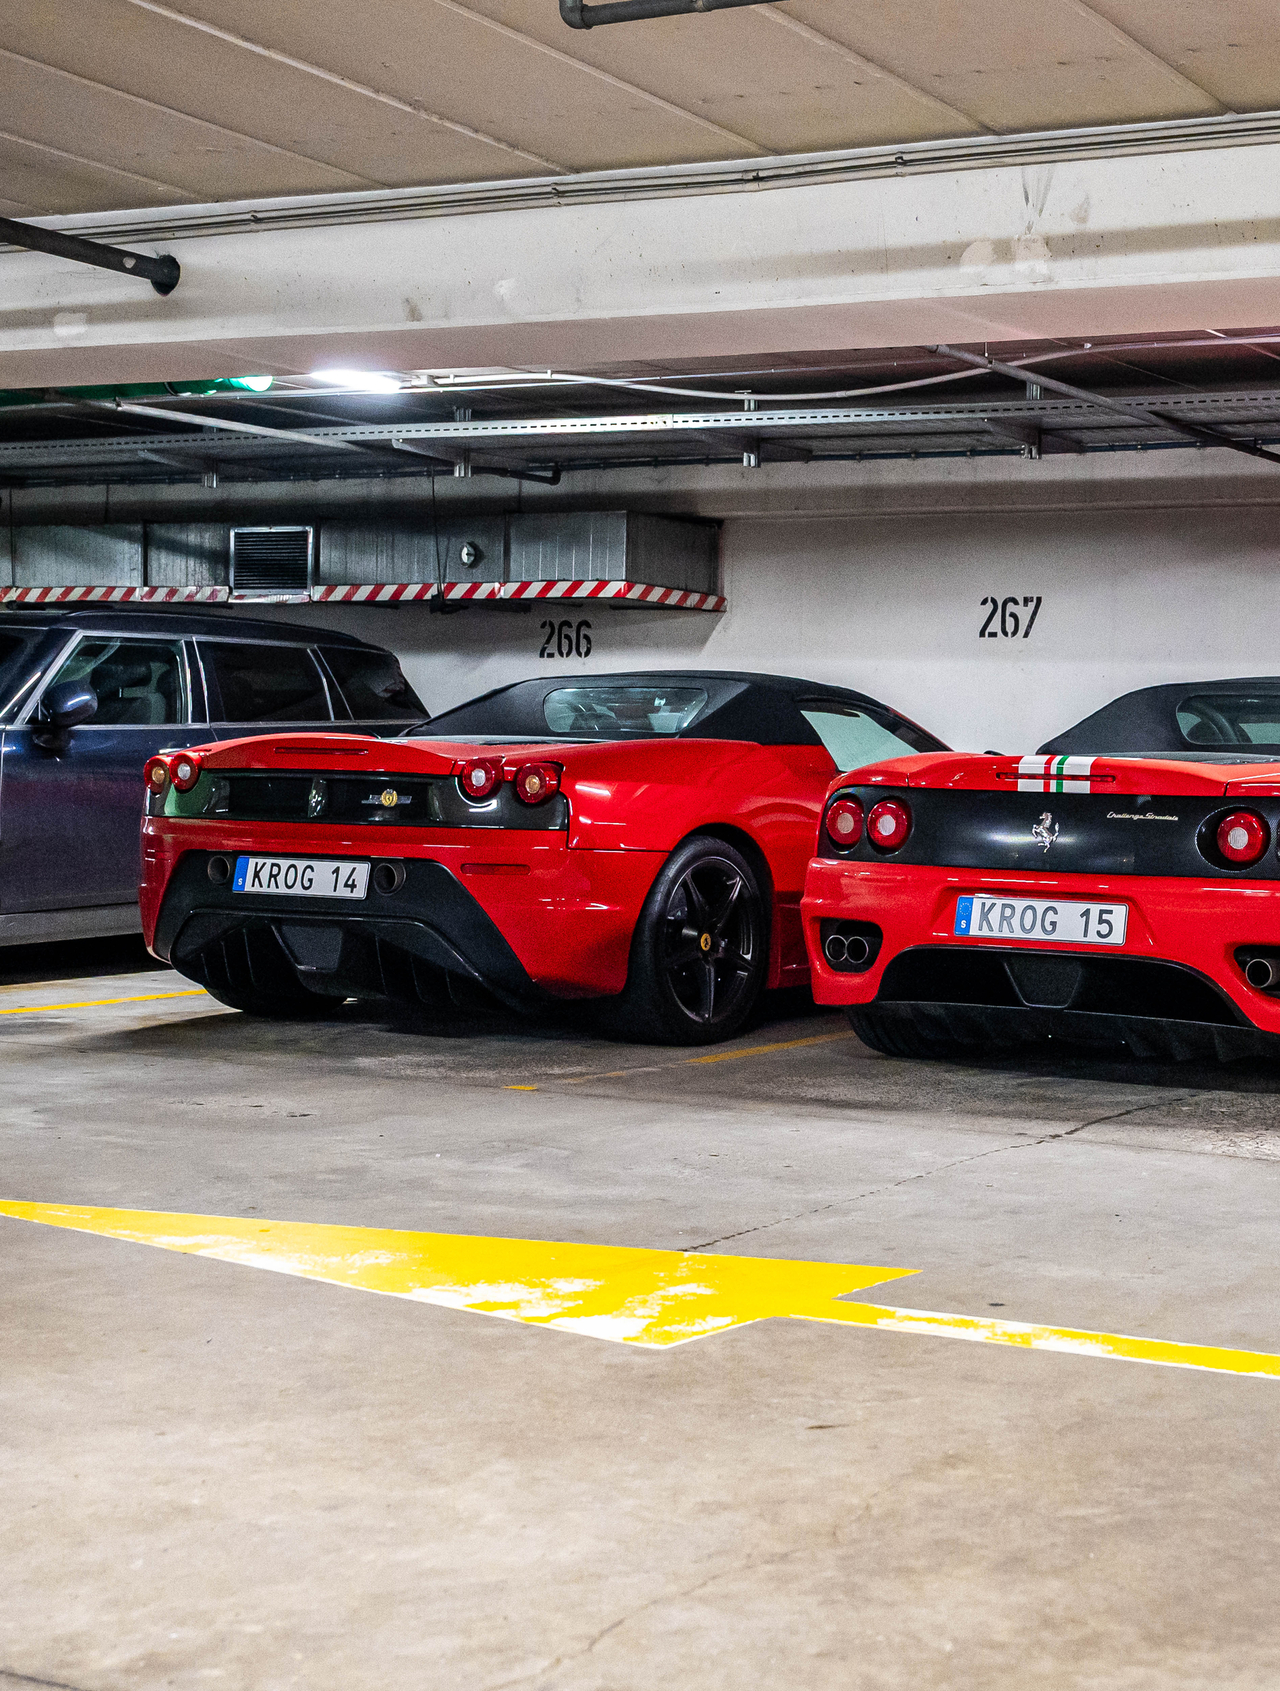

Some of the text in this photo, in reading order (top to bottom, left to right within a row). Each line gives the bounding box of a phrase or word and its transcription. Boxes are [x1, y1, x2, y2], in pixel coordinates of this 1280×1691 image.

[979, 595, 1043, 639] 267
[539, 619, 592, 659] 266
[237, 878, 243, 886] S
[251, 861, 357, 894] KROG 14
[960, 920, 967, 929] S
[978, 901, 1115, 940] KROG 15
